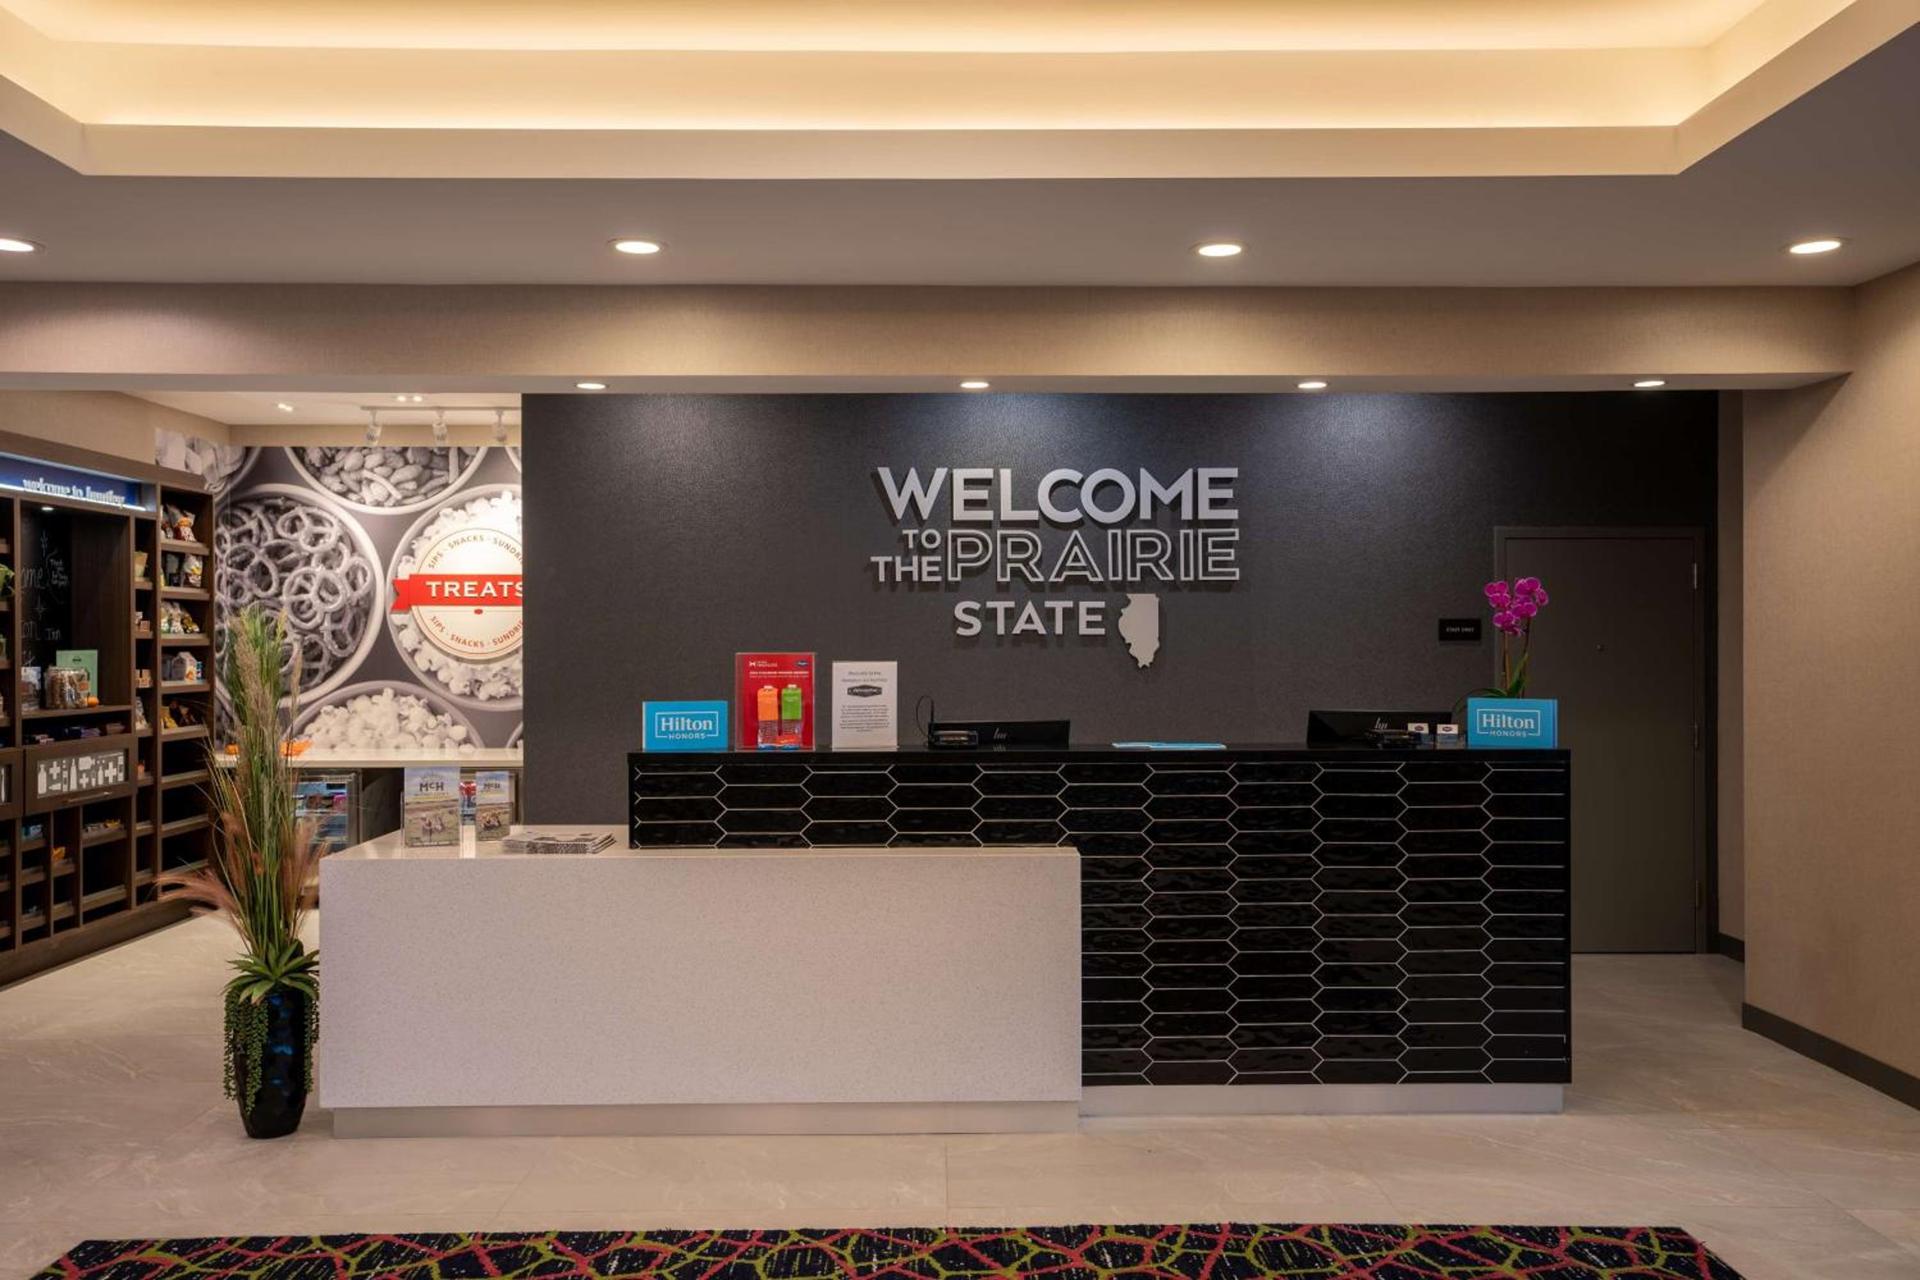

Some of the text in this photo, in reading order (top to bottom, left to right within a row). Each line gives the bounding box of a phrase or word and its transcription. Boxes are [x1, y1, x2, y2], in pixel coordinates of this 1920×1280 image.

[22, 477, 71, 496] welcome
[72, 485, 84, 498] to
[877, 467, 1239, 523] WELCOME
[428, 551, 444, 569] SIPS
[448, 534, 485, 550] SNACKS
[902, 529, 942, 550] TO
[870, 528, 1240, 582] THE PRAIRIE
[953, 600, 1106, 636] STATE
[431, 615, 446, 633] SIPS
[450, 634, 485, 649] SNACKS
[661, 717, 713, 731] Hilton
[1482, 713, 1535, 730] Hilton
[668, 732, 706, 740] HONORS
